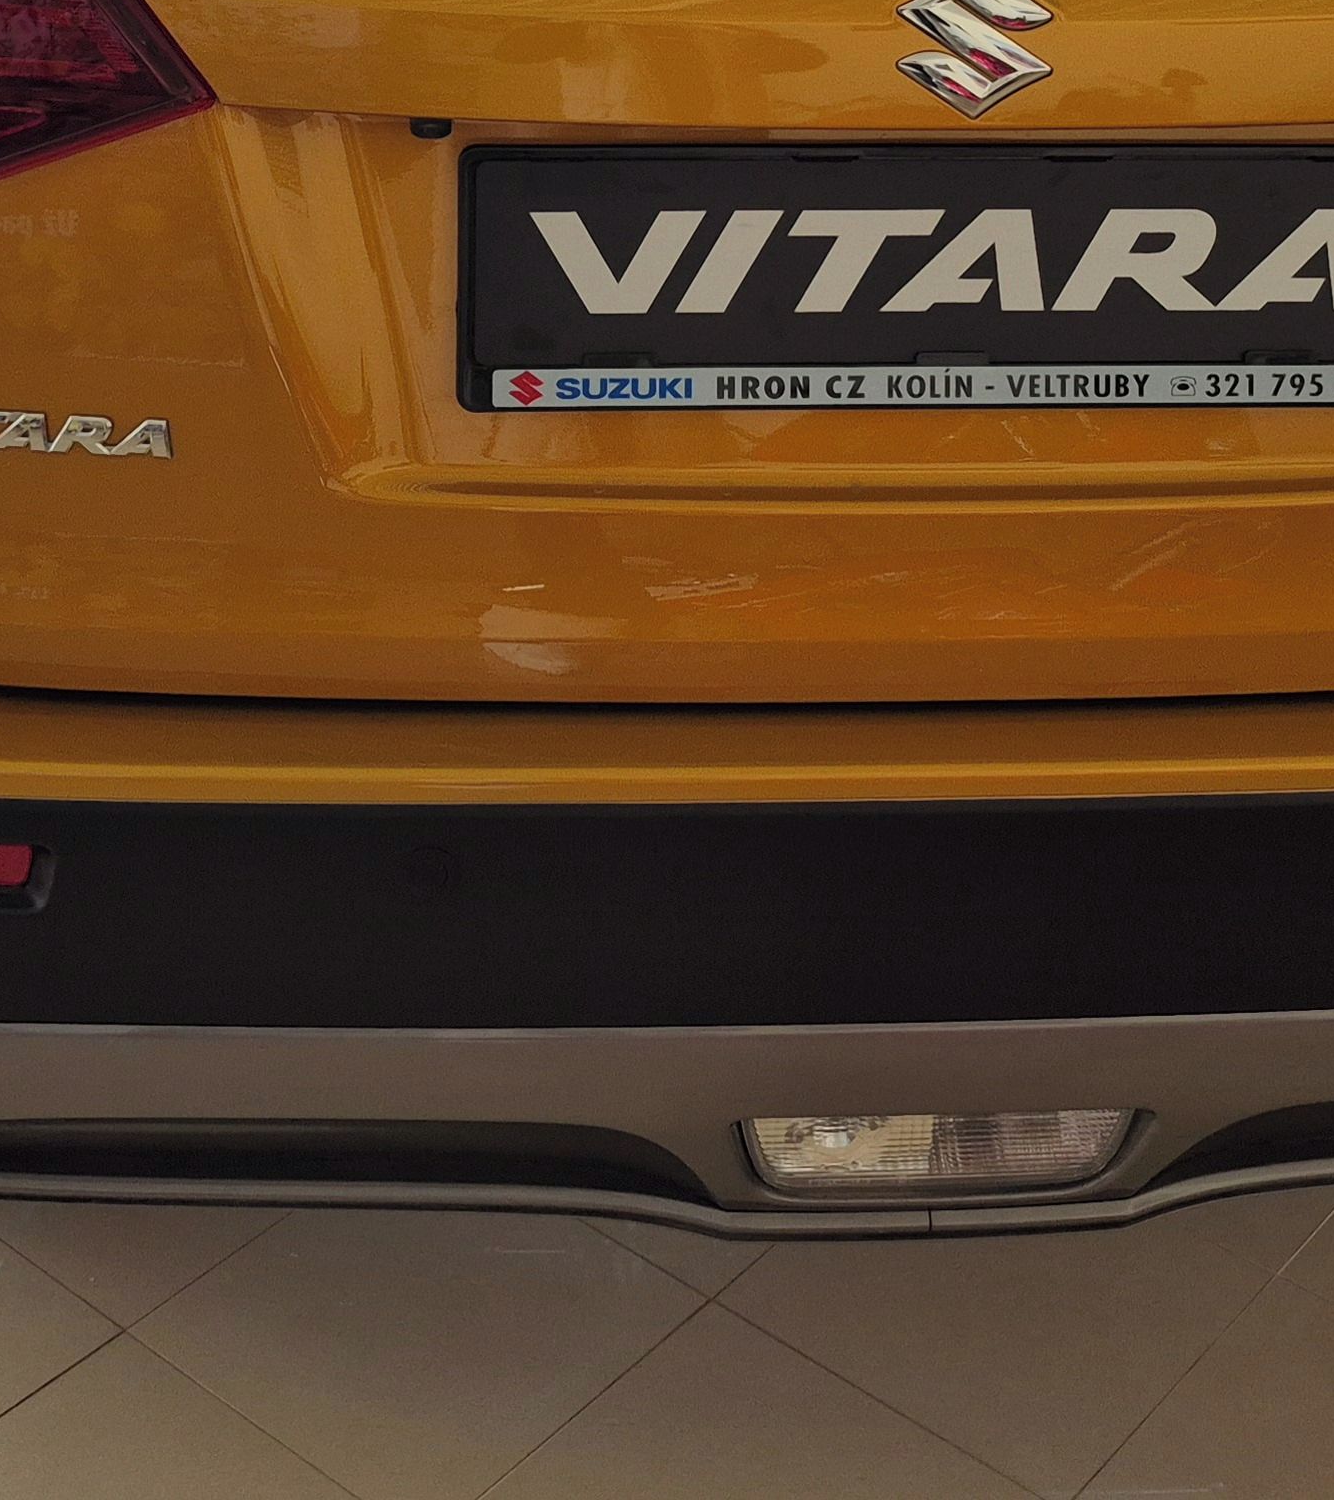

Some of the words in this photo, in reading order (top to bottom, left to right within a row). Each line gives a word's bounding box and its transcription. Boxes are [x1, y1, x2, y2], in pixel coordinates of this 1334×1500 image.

[556, 376, 693, 400] SUZUKI
[717, 374, 810, 399] HRON
[825, 374, 866, 399] CZ
[888, 367, 973, 398] KOLÍN
[1007, 372, 1151, 398] VELTRUBY
[1205, 372, 1255, 397] 321
[1271, 372, 1324, 397] 795
